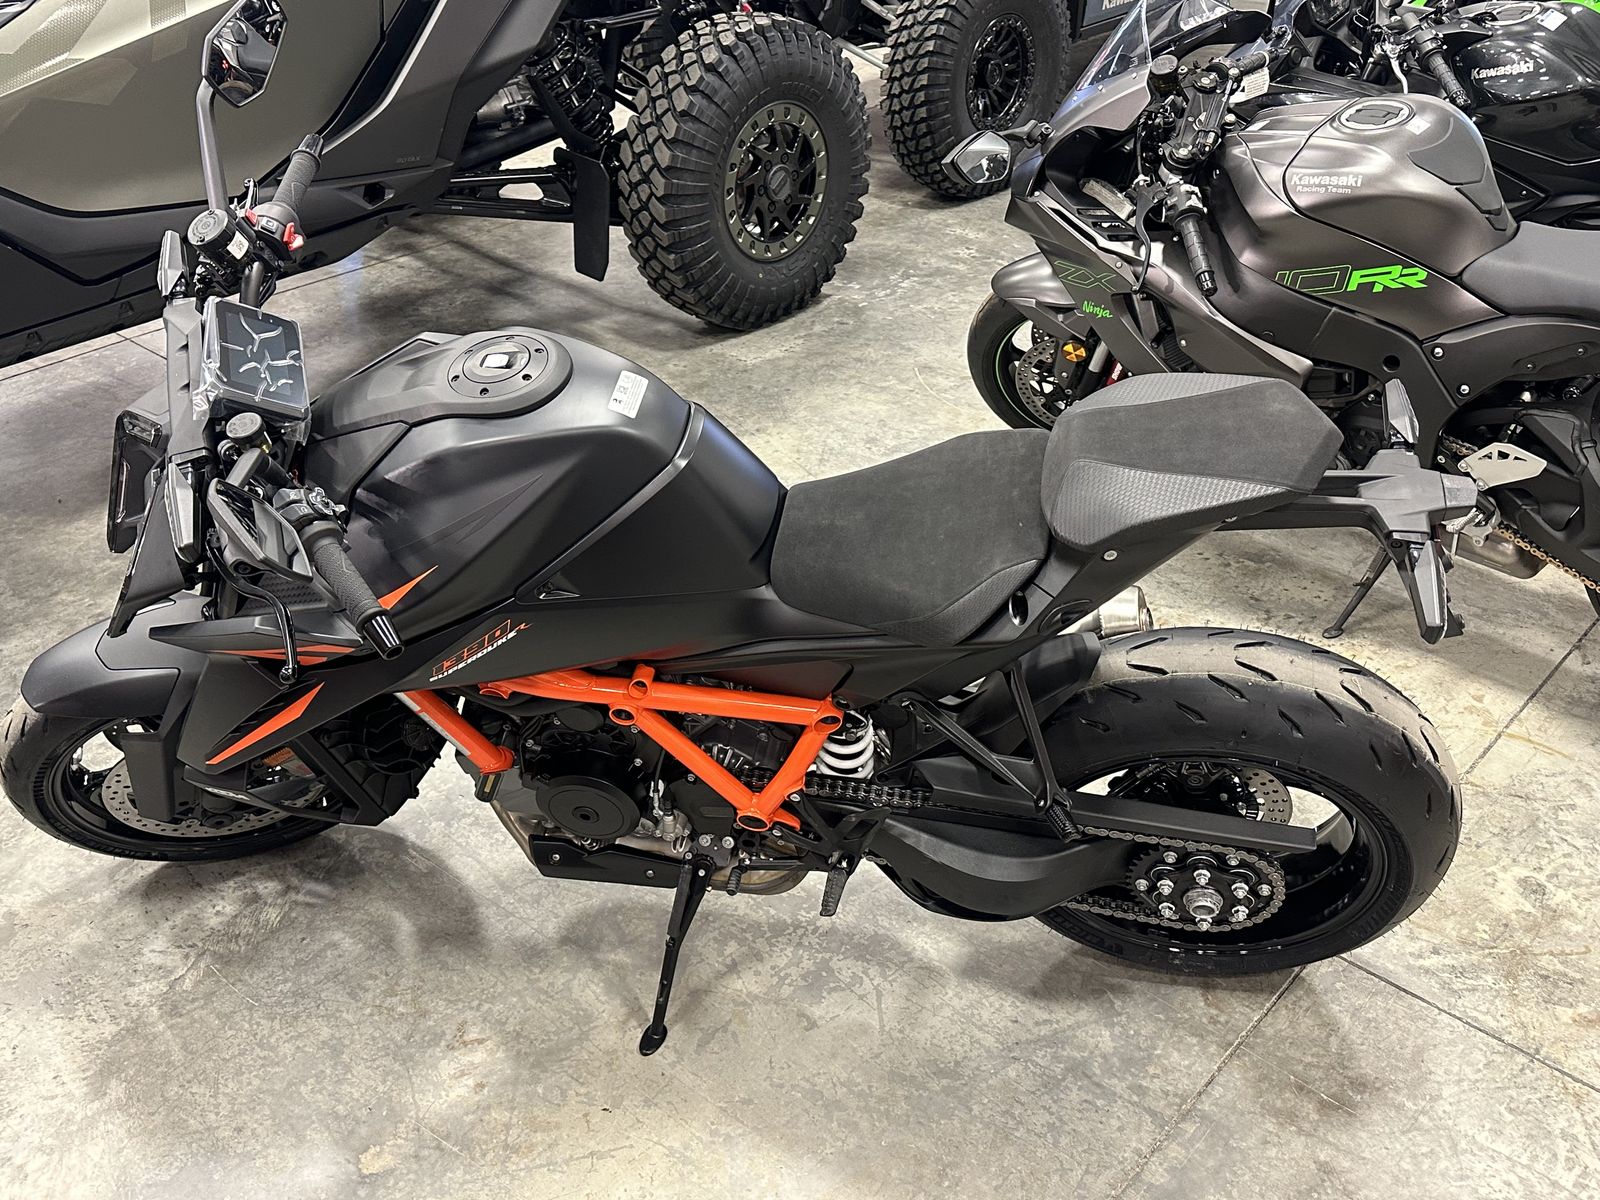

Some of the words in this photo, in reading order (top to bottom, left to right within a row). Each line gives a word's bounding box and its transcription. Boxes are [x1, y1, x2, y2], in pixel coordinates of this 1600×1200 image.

[1471, 60, 1534, 79] Kawasaki
[1291, 174, 1363, 187] Kawasaki
[1297, 186, 1326, 194] Racing
[1327, 186, 1351, 194] Team
[1054, 260, 1117, 293] ZX
[1082, 300, 1114, 319] Ninja
